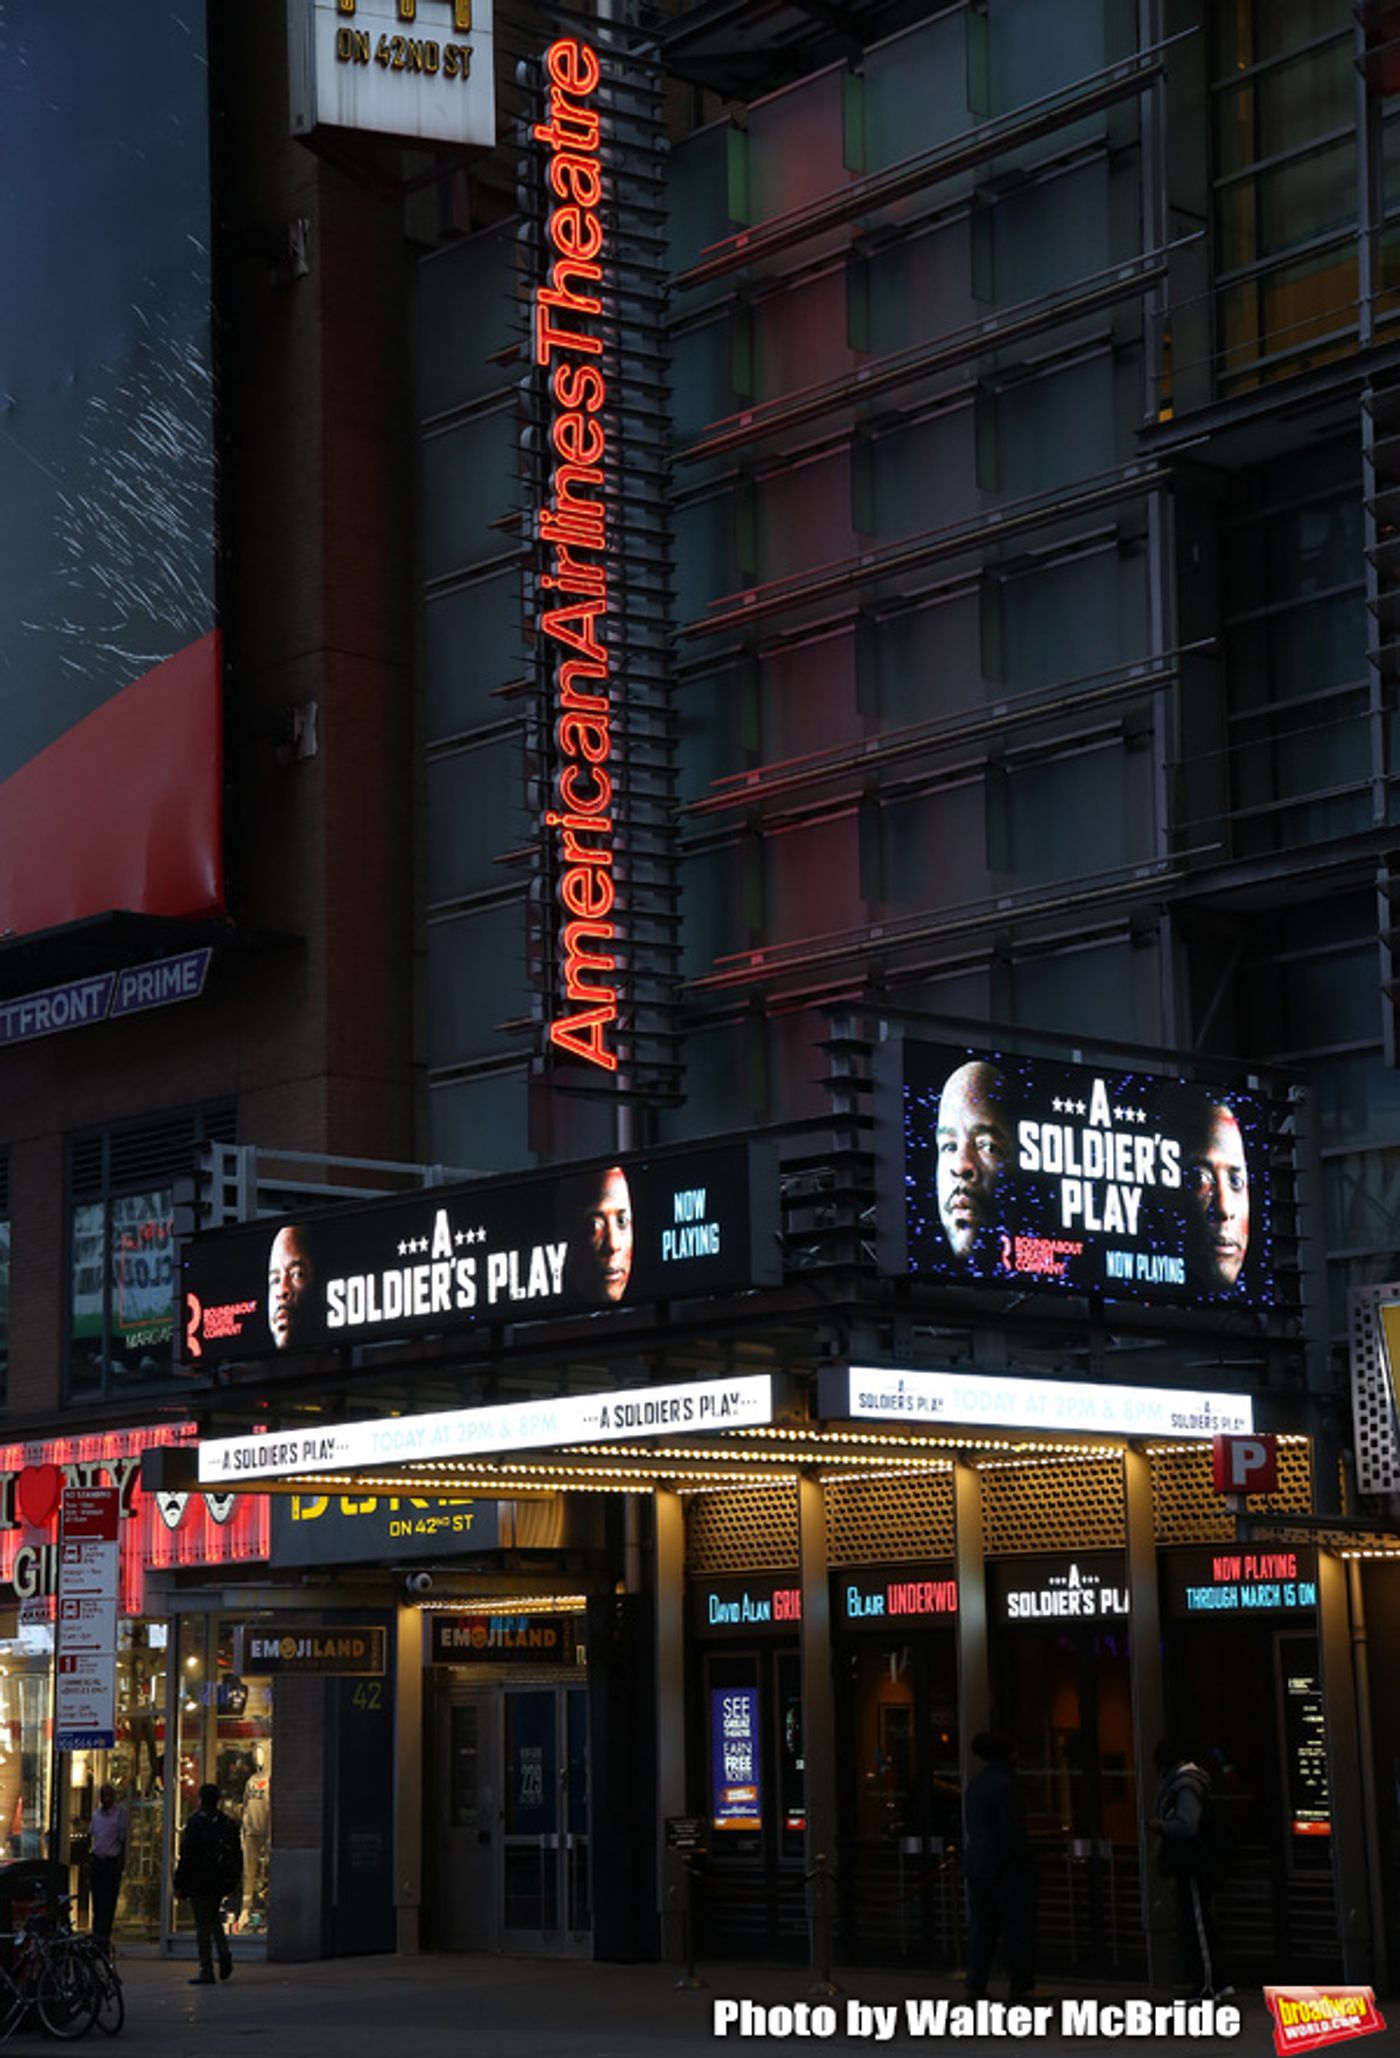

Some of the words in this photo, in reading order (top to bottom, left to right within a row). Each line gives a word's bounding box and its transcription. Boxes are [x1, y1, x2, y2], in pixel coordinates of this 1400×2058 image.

[336, 28, 370, 65] ON
[374, 33, 440, 74] 42ND
[444, 43, 474, 80] ST
[122, 958, 199, 1007] PRIME
[1088, 1078, 1113, 1129] A
[1018, 1120, 1183, 1189] SOLDIER'S
[673, 1187, 707, 1223] NOW
[1060, 1178, 1143, 1236] PLAY
[431, 1208, 454, 1260] A
[662, 1222, 721, 1262] PLAYING
[325, 1256, 477, 1329] SOLDIER'S
[487, 1242, 568, 1304] PLAY
[1105, 1250, 1135, 1280] NOW
[1137, 1252, 1186, 1286] PLAYING
[599, 1406, 611, 1429] A
[699, 1391, 741, 1419] PLAY
[951, 1388, 1018, 1413] TODAY
[1024, 1391, 1047, 1414] AT
[1054, 1394, 1097, 1418] 2PM
[1122, 1399, 1164, 1423] 8PM
[371, 1425, 427, 1452] TODAY
[432, 1423, 451, 1446] AT
[457, 1419, 495, 1443] 2PM
[519, 1412, 558, 1436] 8PM
[222, 1449, 232, 1471] A
[303, 1437, 336, 1462] PLAY
[1231, 1441, 1267, 1486] P
[389, 1520, 412, 1537] ON
[452, 1513, 475, 1532] ST
[1067, 1563, 1082, 1589] A
[1213, 1556, 1241, 1581] NOW
[1244, 1553, 1297, 1579] PLAYING
[887, 1581, 958, 1615] UNDERWO
[1007, 1586, 1095, 1618] SOLDIER'S
[1186, 1586, 1238, 1610] THROUGH
[1240, 1584, 1281, 1608] MARCH
[1298, 1582, 1316, 1607] ON
[251, 1636, 366, 1662] EMOJILAND
[441, 1626, 557, 1650] EMOJILAND
[352, 1682, 382, 1710] 42
[723, 1696, 751, 1719] SEE
[725, 1756, 752, 1771] FREE
